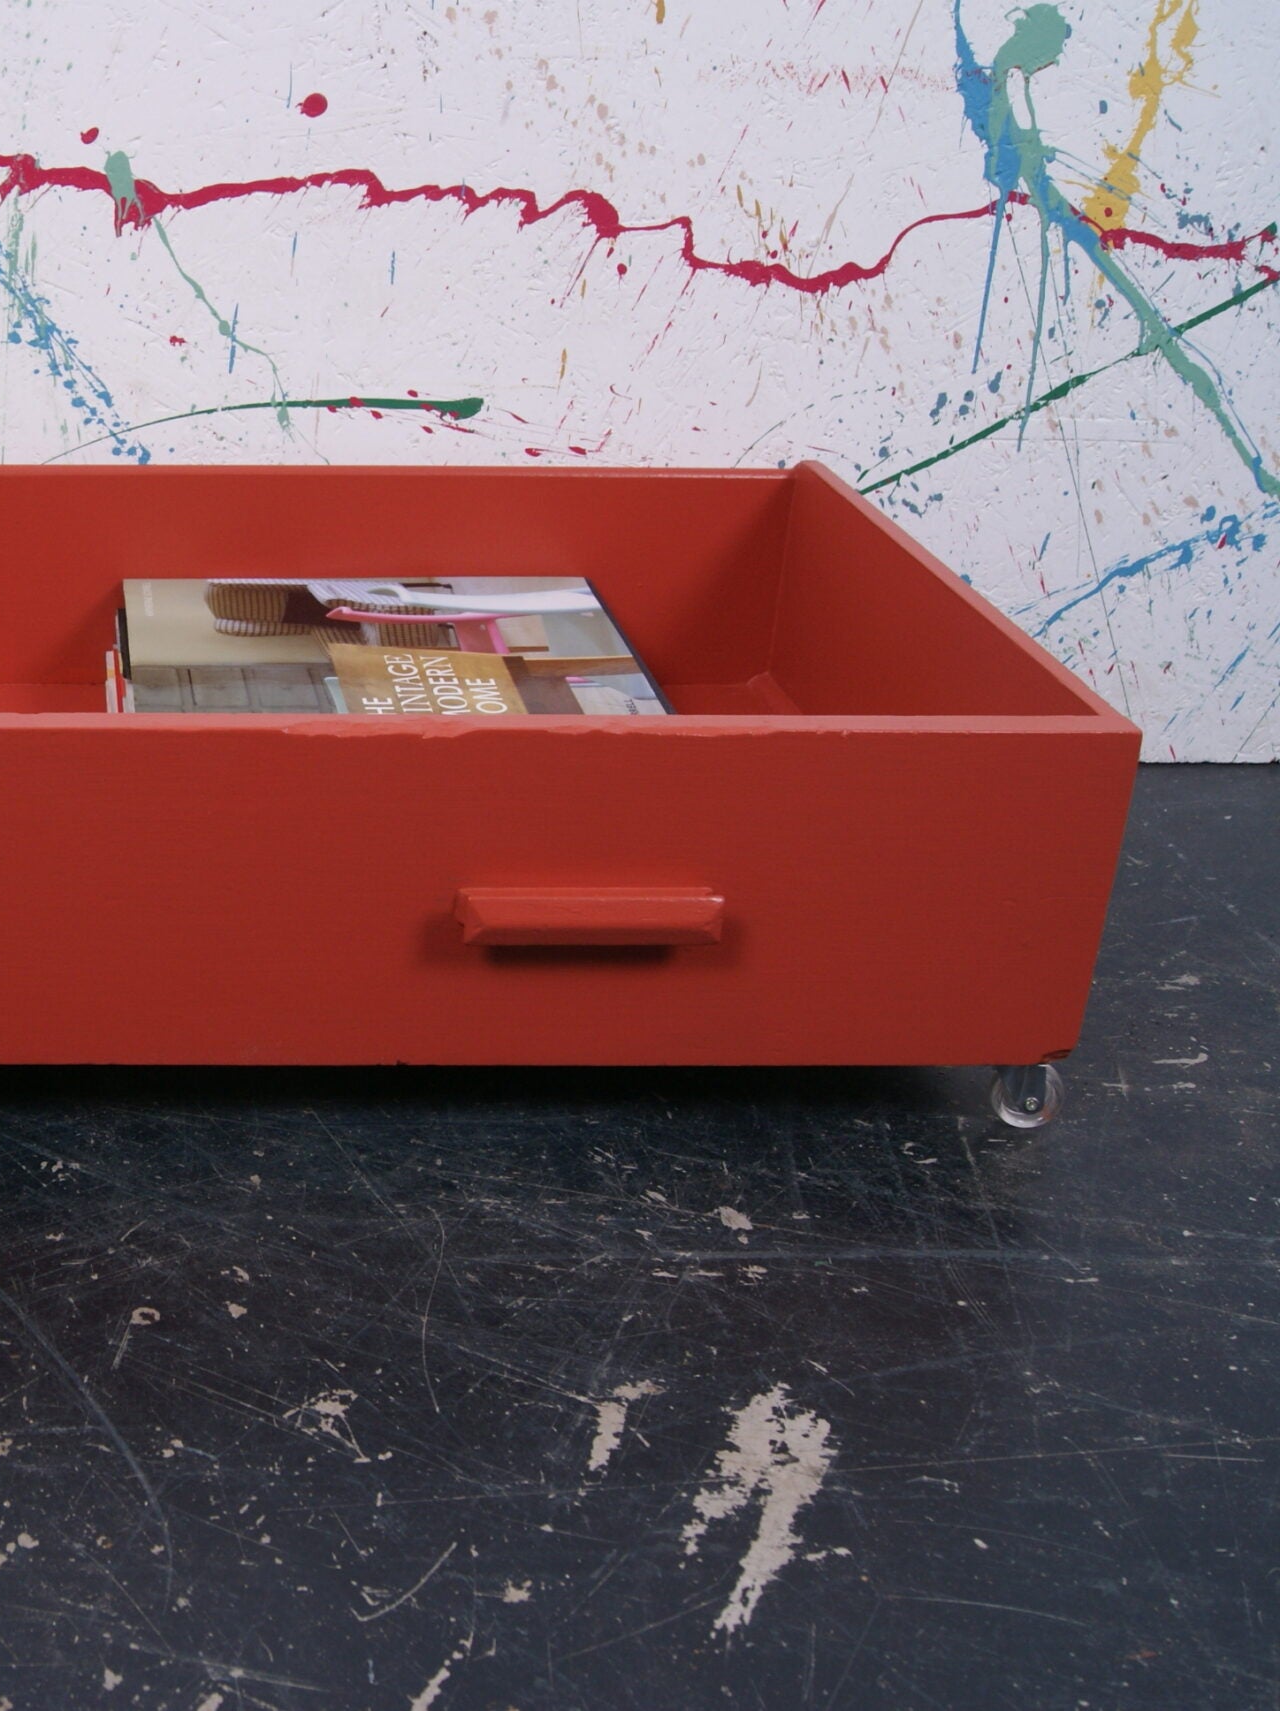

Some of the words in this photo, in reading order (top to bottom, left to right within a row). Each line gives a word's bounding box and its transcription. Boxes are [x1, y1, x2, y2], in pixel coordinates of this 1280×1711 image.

[384, 653, 433, 715] INTAGE
[466, 678, 508, 715] OME
[363, 697, 394, 715] HE
